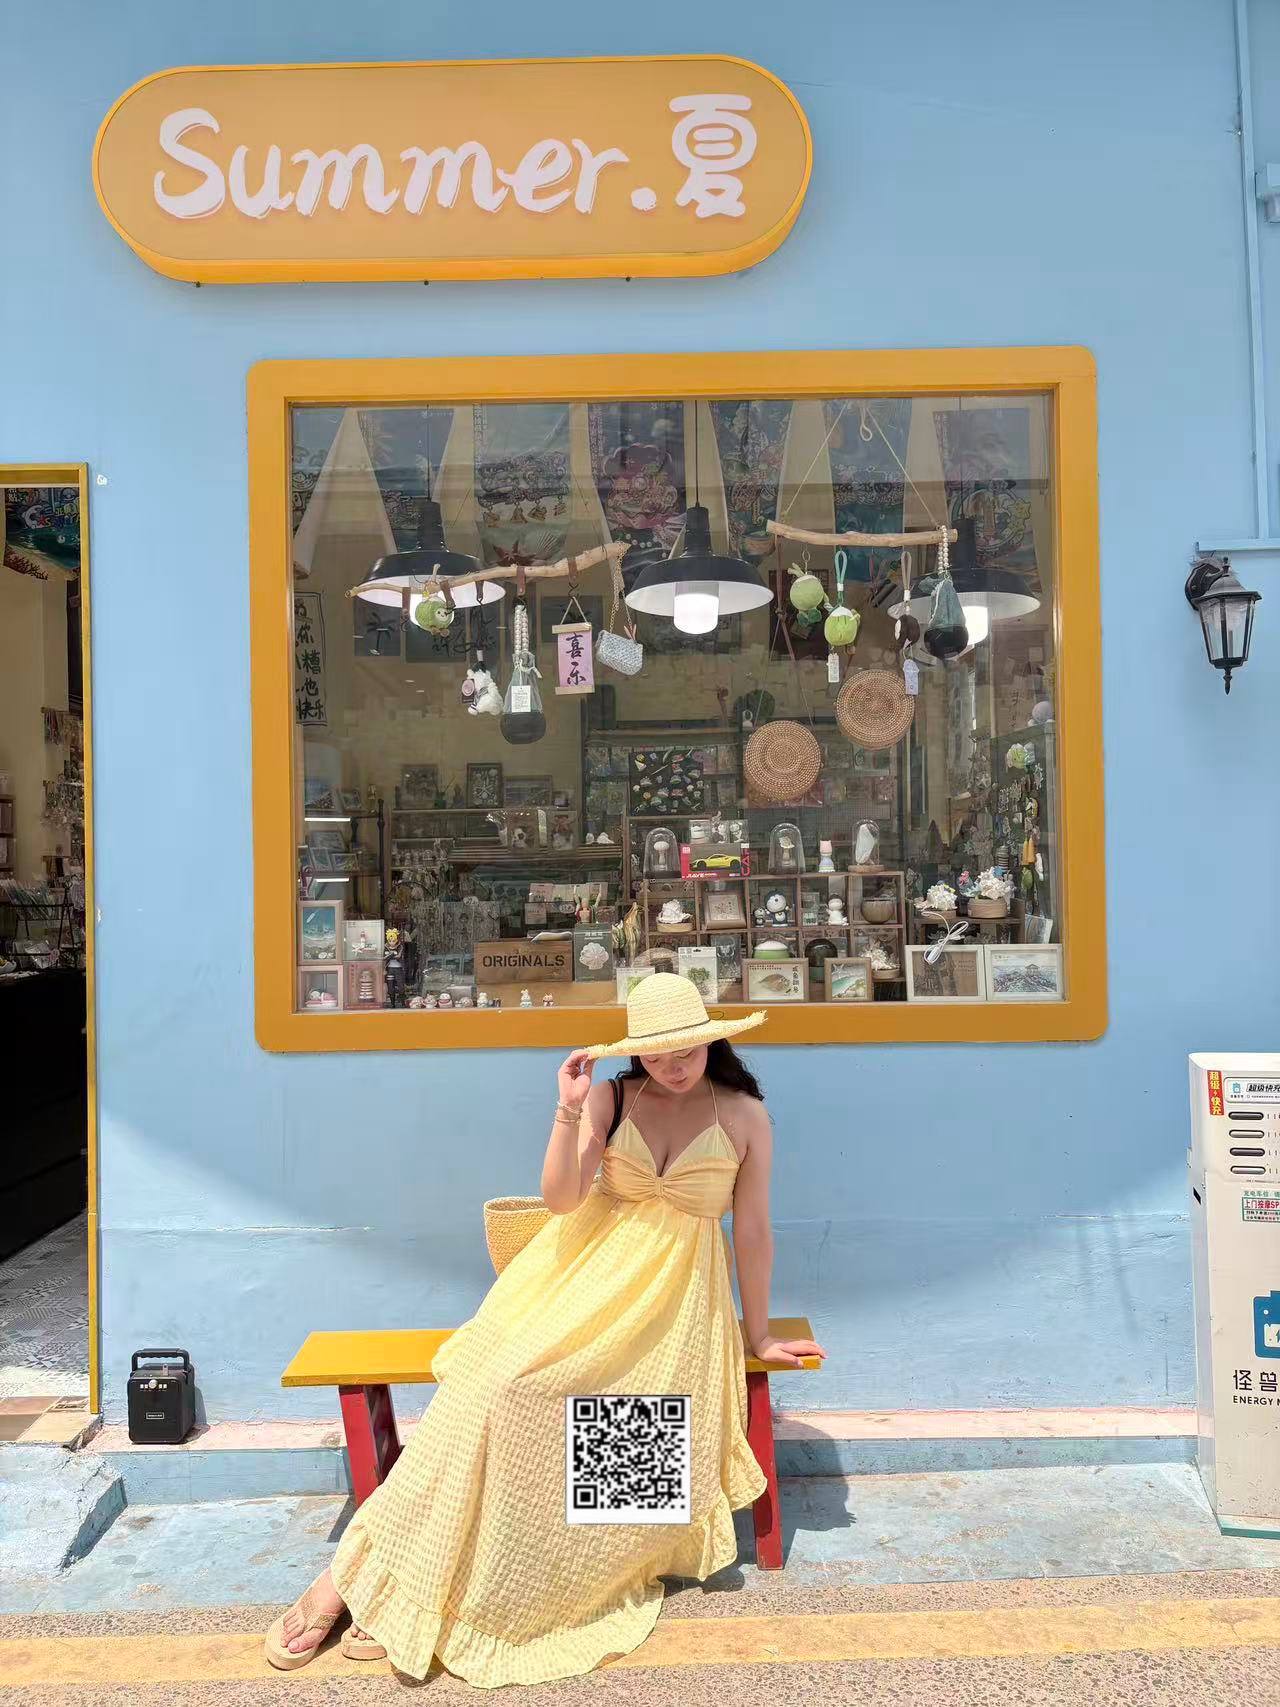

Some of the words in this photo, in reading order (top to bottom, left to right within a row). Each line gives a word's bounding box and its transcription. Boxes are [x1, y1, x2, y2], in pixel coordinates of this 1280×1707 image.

[482, 954, 565, 967] ORIGINALS
[1233, 1369, 1278, 1392] 怪兽
[1233, 1395, 1274, 1406] ENERGY
